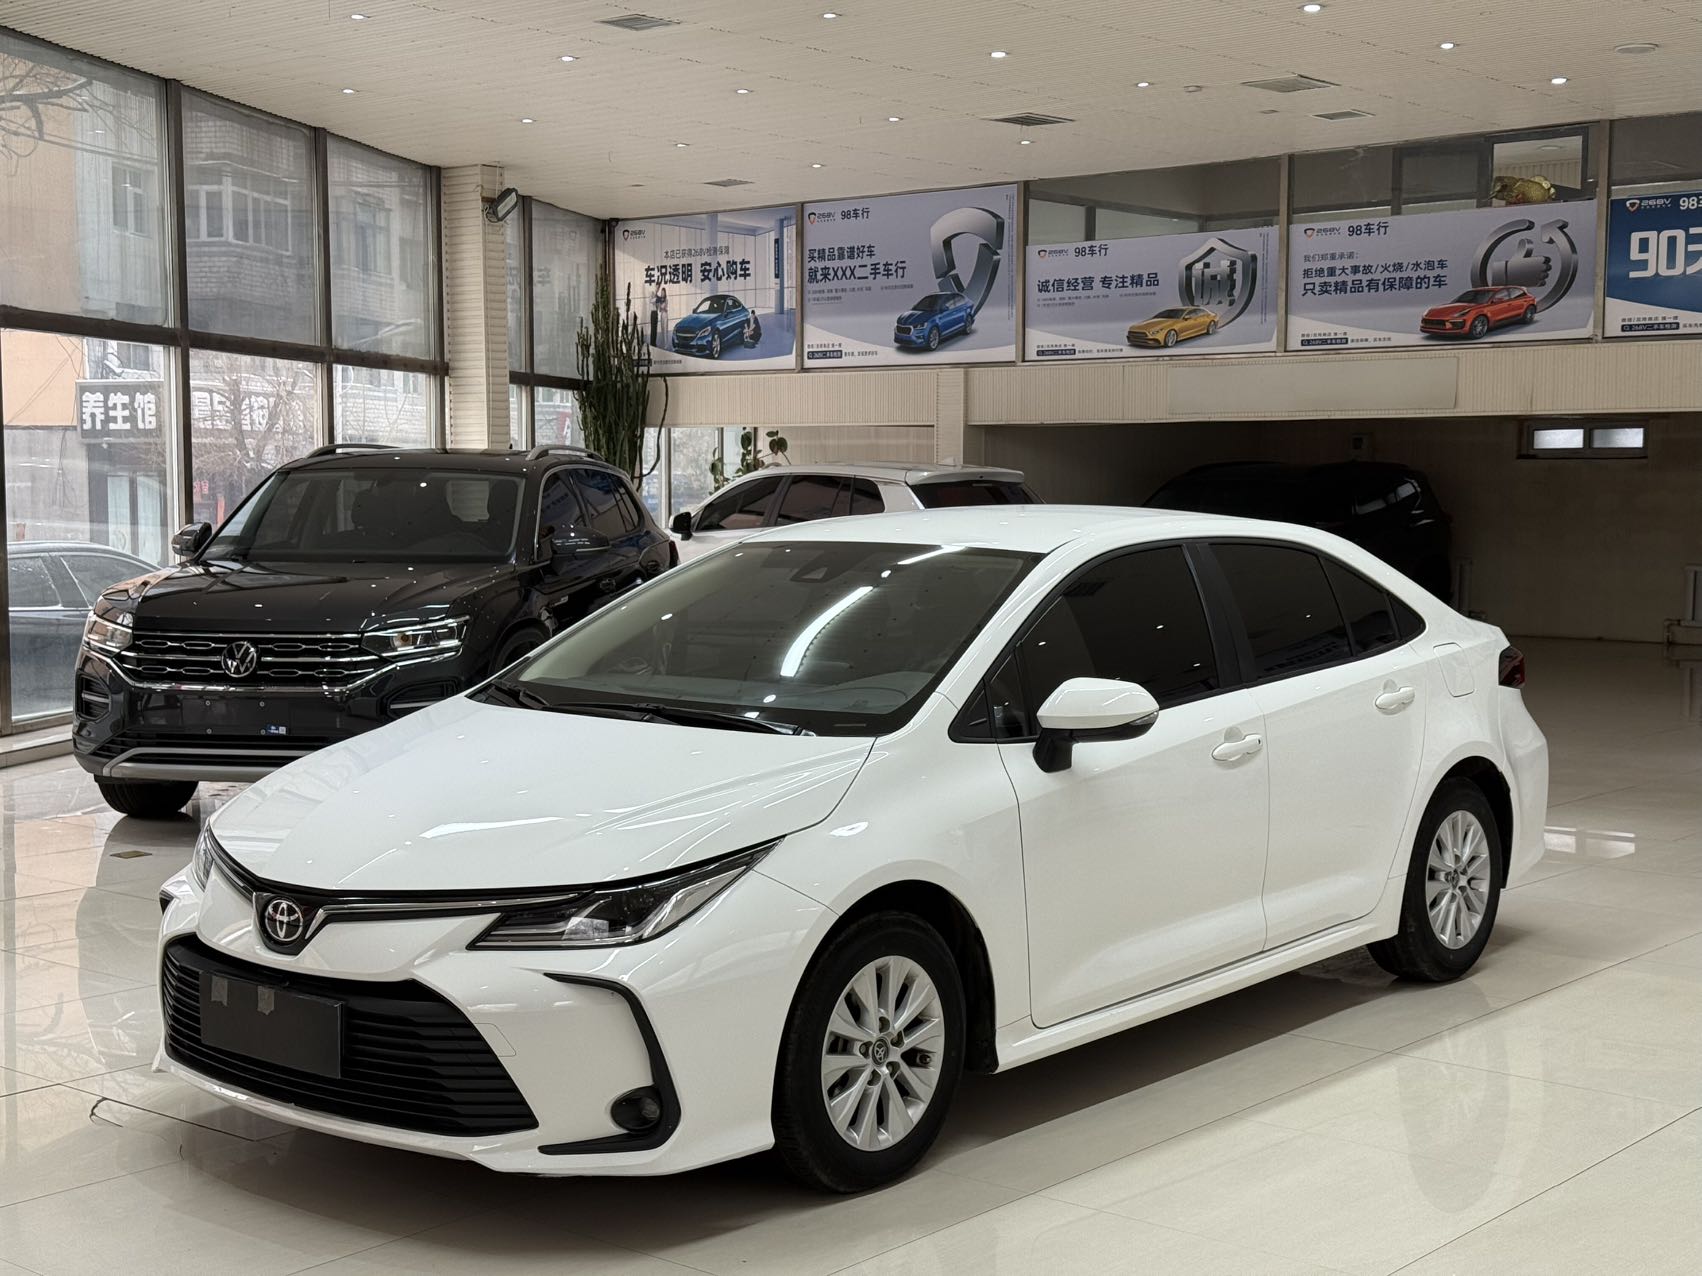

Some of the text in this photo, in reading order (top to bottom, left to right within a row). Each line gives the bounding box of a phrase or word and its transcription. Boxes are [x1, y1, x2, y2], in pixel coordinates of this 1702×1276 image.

[840, 207, 871, 220] 98车行
[1347, 221, 1389, 237] 98车行
[807, 244, 876, 264] 买精品靠谱好车
[1074, 243, 1109, 257] 98车行
[644, 262, 693, 286] 车况透明
[700, 258, 752, 283] 安心购车
[806, 260, 907, 284] 就来XXX二手车行
[1302, 259, 1449, 280] 拒绝重大事故/火烧/水泡车
[1036, 272, 1160, 294] 诚信经营 专注精品
[1301, 274, 1448, 297] 只卖精品有保障的车
[81, 391, 157, 431] 养生馆
